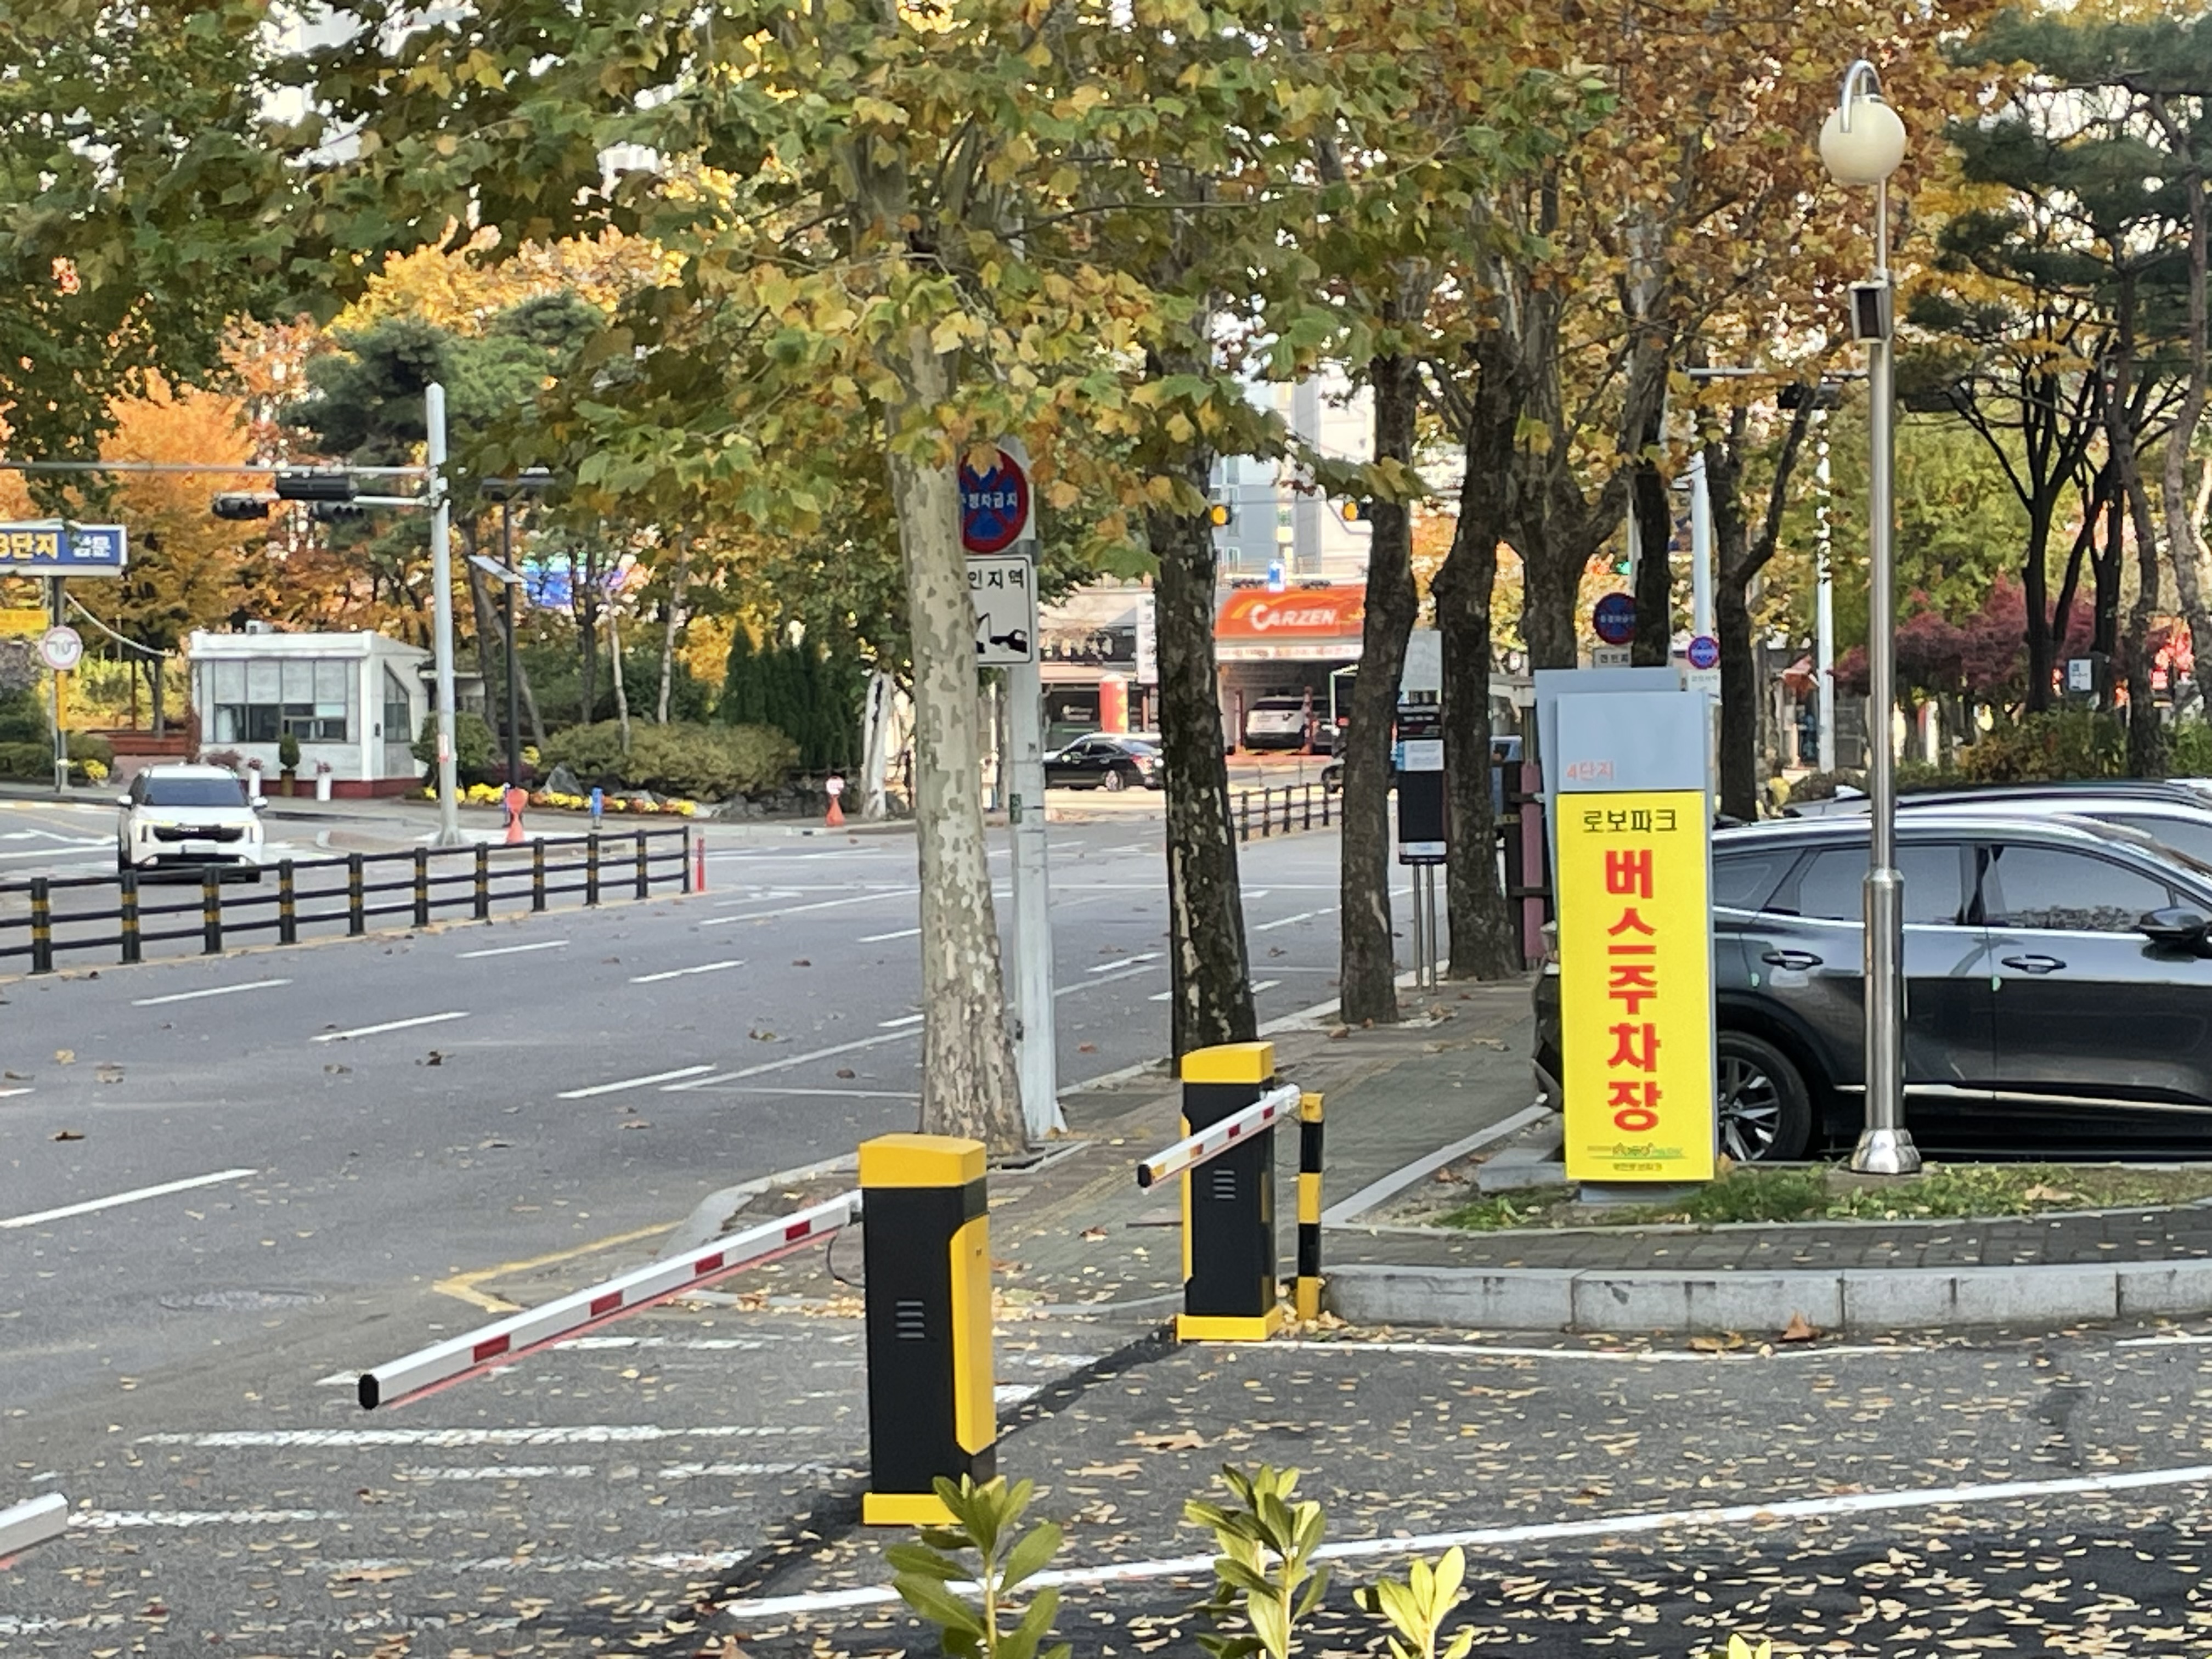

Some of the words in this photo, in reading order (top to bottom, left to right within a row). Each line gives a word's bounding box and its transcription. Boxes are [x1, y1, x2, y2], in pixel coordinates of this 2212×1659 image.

[968, 568, 1024, 590] 인지역
[1250, 602, 1337, 631] CARZEN
[1566, 760, 1614, 781] 4단지
[1583, 809, 1677, 833] 로보파크
[1605, 849, 1662, 1132] 버스주차장
